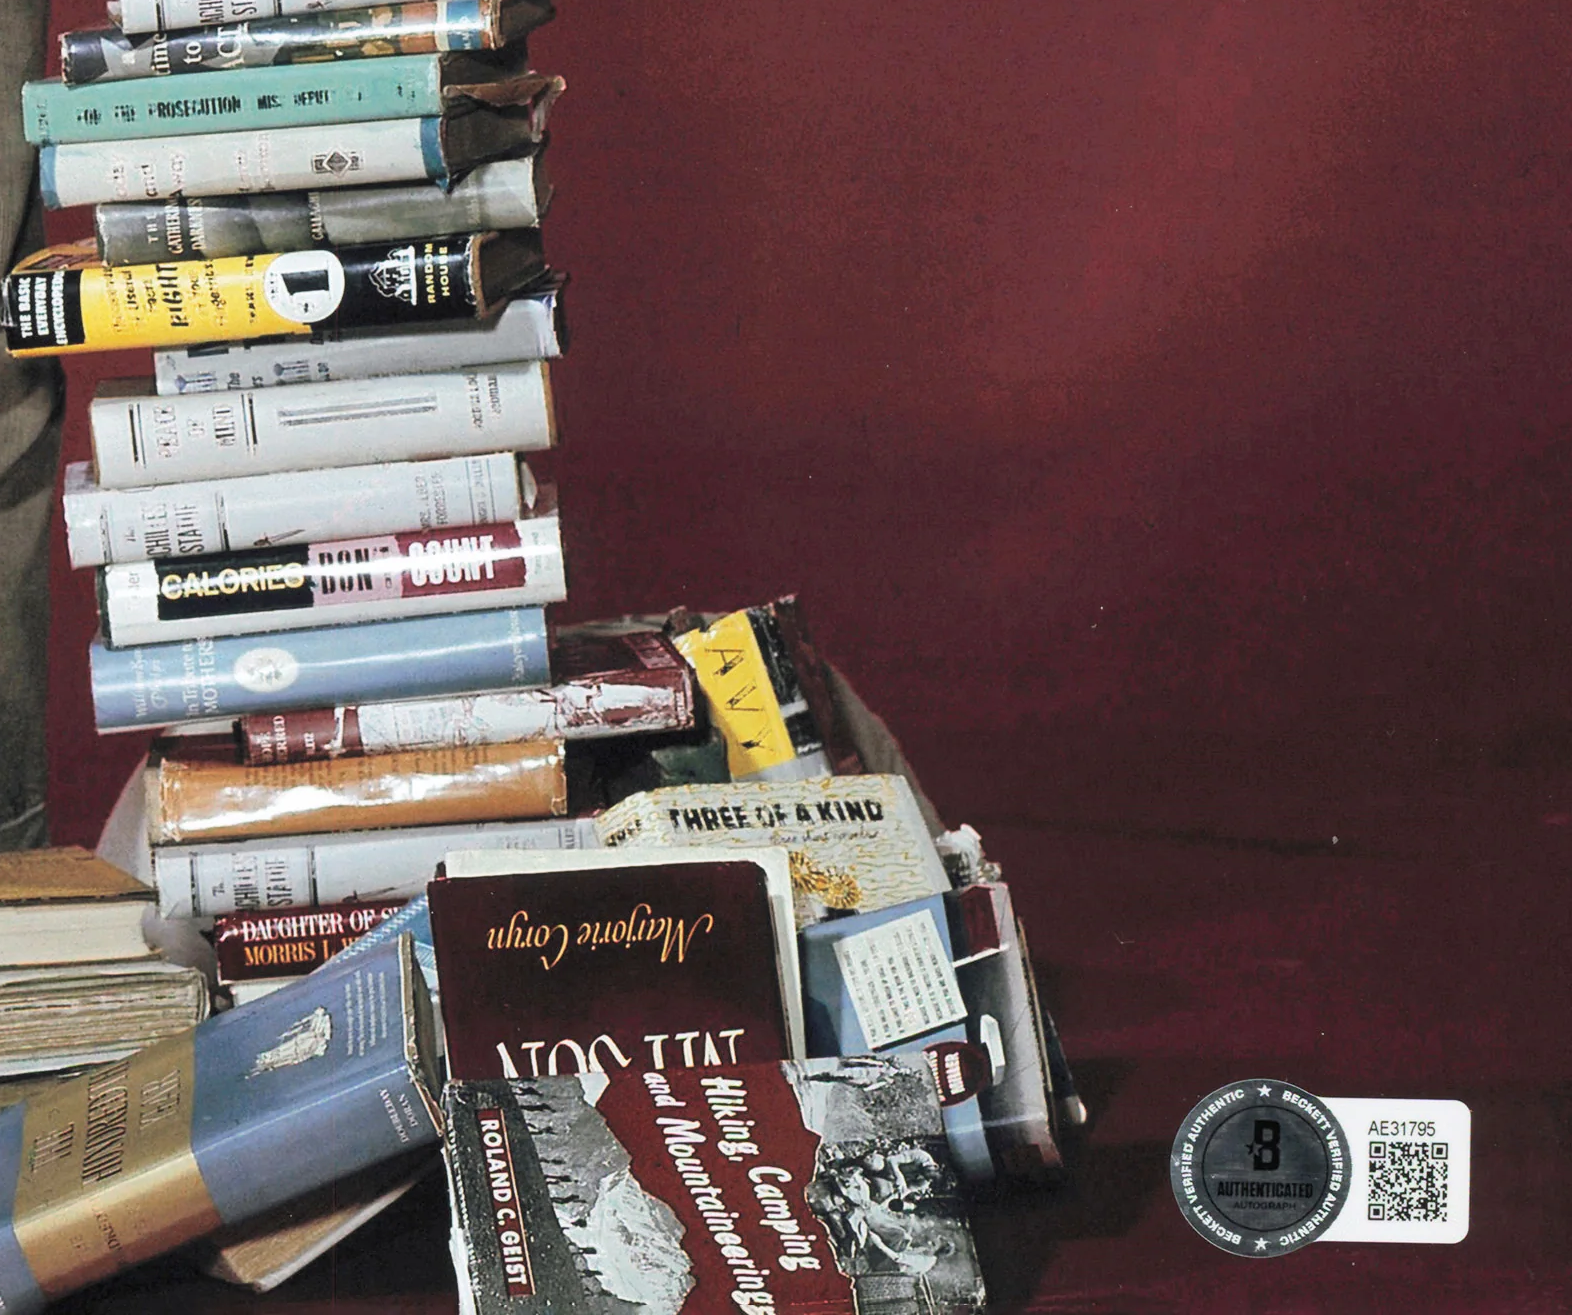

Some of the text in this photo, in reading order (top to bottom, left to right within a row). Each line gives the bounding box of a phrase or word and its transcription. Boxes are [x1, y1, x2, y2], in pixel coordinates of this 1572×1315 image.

[153, 31, 168, 74] time
[183, 39, 202, 65] to
[216, 23, 246, 71] ACT
[425, 242, 436, 304] RANDOM
[440, 245, 450, 298] HOUSE
[19, 275, 31, 339] THE BASIC
[36, 276, 49, 337] EVERYDAY
[144, 500, 172, 560] CHILLES
[161, 560, 306, 601] CALORIES
[408, 534, 495, 587] COUNT
[668, 800, 752, 833] THREE
[755, 802, 793, 829] OF
[796, 801, 815, 825] A
[816, 797, 885, 825] KIND
[232, 851, 260, 912] CHILLES
[240, 910, 375, 941] DAUGHTER OF
[486, 902, 715, 971] Marjorie Coryn
[242, 938, 317, 968] MORRIS
[642, 1071, 687, 1109] and
[942, 1051, 963, 1095] MILLER
[1368, 1121, 1436, 1137] AE31795
[700, 1075, 823, 1272] Hiking, Camping
[1181, 1088, 1245, 1246] BECKETT VERIFIED AUTHENTIC
[1217, 1181, 1314, 1200] AUTHENTICATED
[1279, 1089, 1344, 1248] BECKETT VERIFIED AUTHENTIC
[479, 1117, 528, 1286] ROLAND C. GEIST
[1232, 1200, 1297, 1212] AUTOGRAPH
